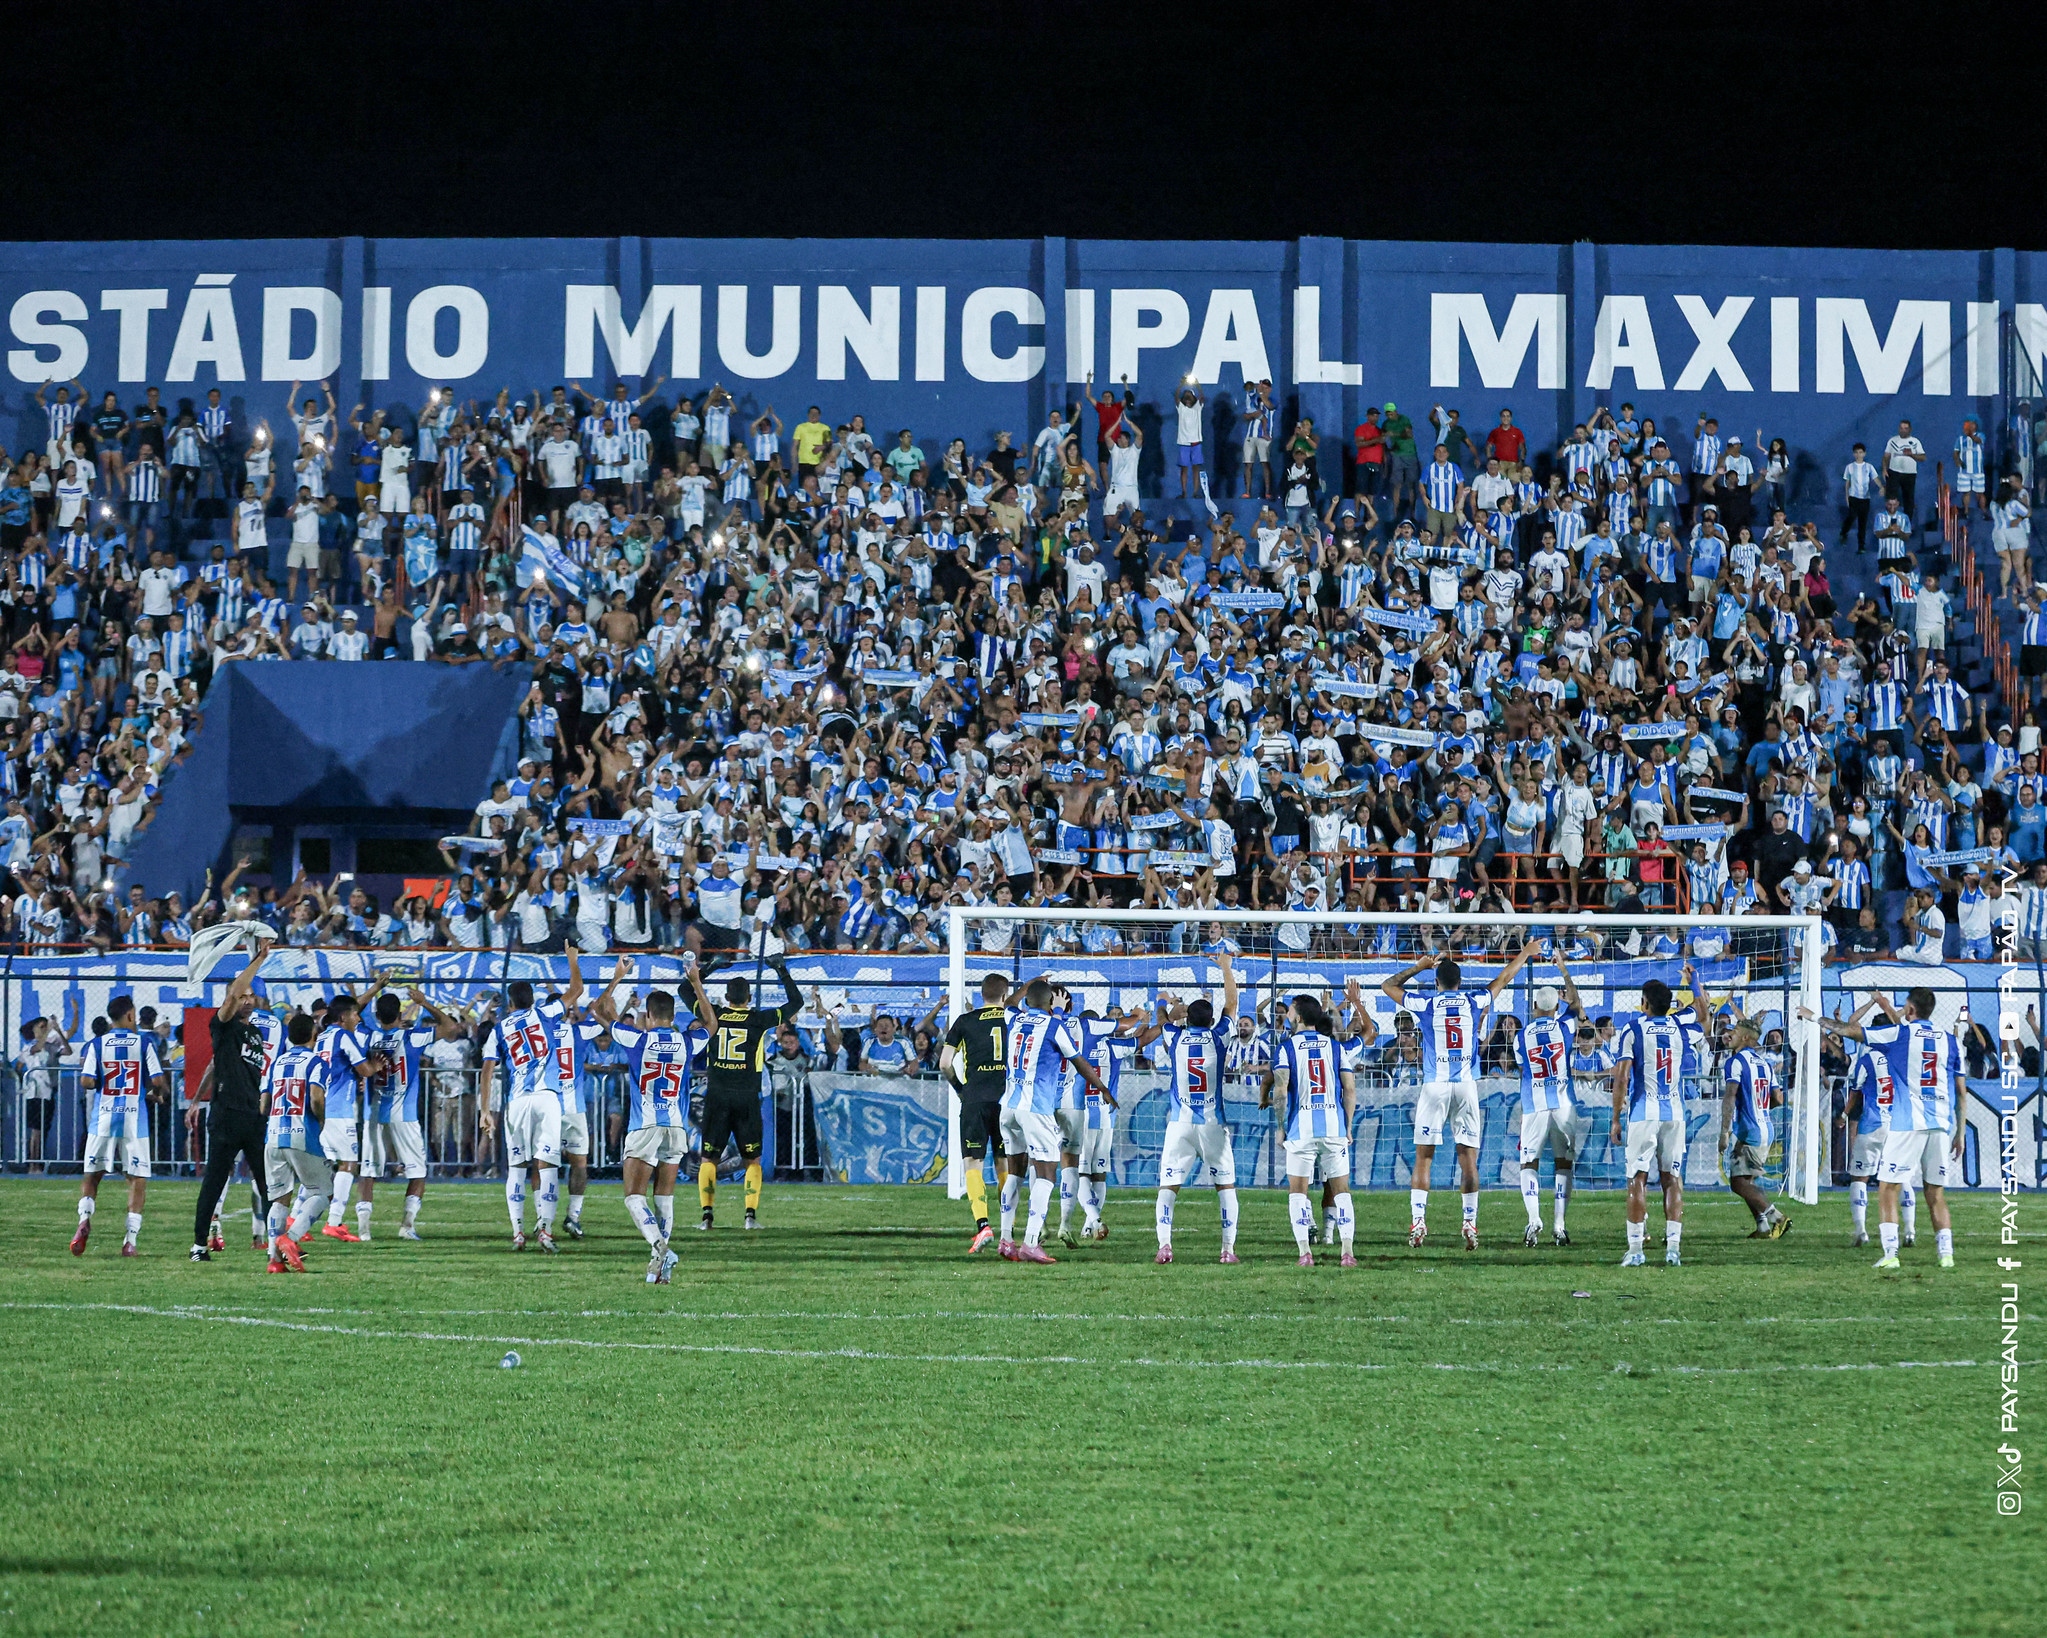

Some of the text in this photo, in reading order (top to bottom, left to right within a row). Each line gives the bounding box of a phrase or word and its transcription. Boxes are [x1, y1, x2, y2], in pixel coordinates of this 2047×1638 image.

[8, 273, 489, 383] STÁDIO
[564, 285, 1362, 385] MUNICIPAL
[1723, 602, 1732, 616] 7
[505, 1024, 549, 1067] 26
[717, 1027, 748, 1061] 12
[990, 1026, 1003, 1061] 1
[1445, 1017, 1464, 1049] 6
[713, 1062, 747, 1070] ALUBAR
[1187, 1058, 1208, 1093] 5
[1308, 1058, 1327, 1094] 9
[1437, 1055, 1472, 1063] ALUBAR
[1527, 1042, 1564, 1079] 57
[1656, 1048, 1673, 1084] 4
[1920, 1051, 1938, 1087] 3
[102, 1060, 141, 1096] 23
[639, 1061, 684, 1098] 75
[1532, 1079, 1568, 1088] ALUBAR
[269, 1078, 307, 1117] 29
[1300, 1103, 1336, 1111] ALUBAR
